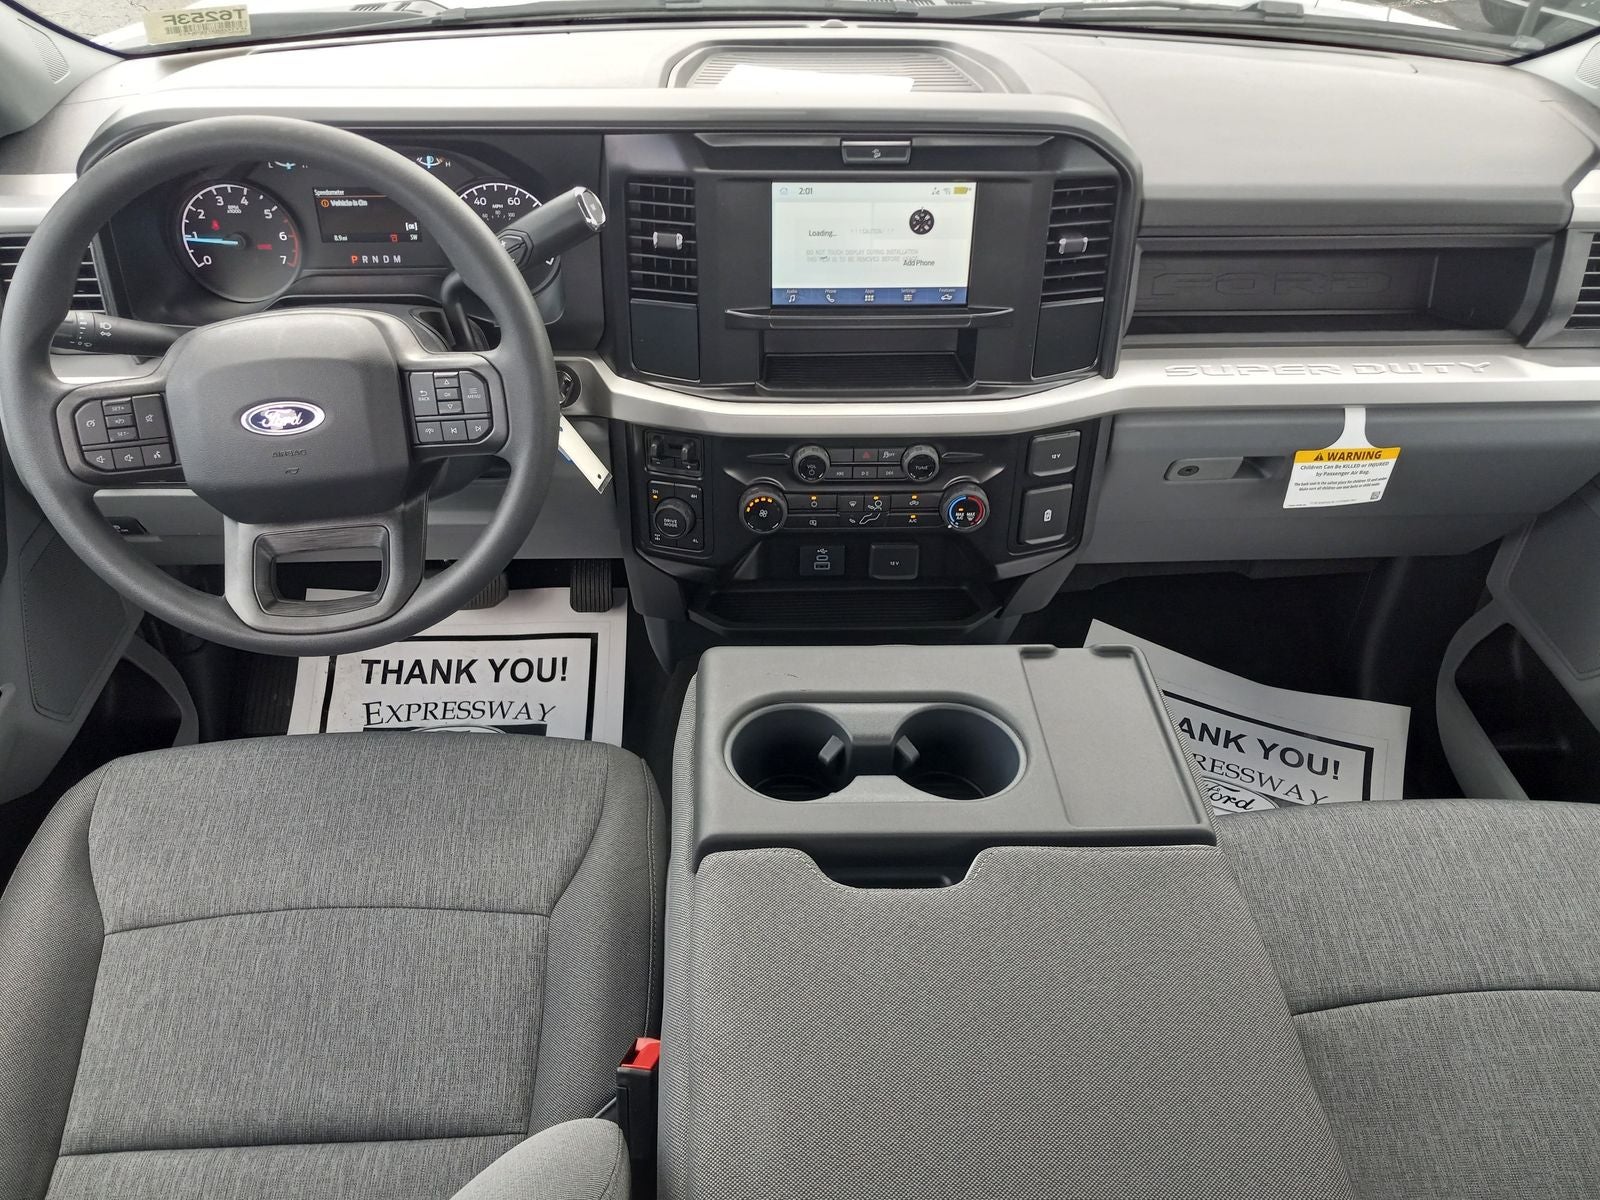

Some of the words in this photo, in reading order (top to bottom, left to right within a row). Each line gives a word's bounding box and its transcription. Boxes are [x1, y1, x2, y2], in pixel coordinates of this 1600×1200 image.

[314, 189, 345, 197] Speedometer
[798, 187, 813, 195] 2:01
[216, 196, 224, 206] 3
[240, 196, 249, 206] 4
[473, 197, 487, 206] 40
[507, 197, 521, 206] 60
[197, 209, 206, 219] 2
[263, 209, 273, 219] 5
[279, 231, 288, 240] 6
[203, 255, 212, 265] 0
[279, 255, 287, 264] 7
[351, 255, 358, 264] P
[362, 255, 369, 263] R
[372, 255, 379, 263] N
[383, 255, 389, 263] D
[393, 255, 401, 263] M
[1152, 271, 1392, 297] FORD
[1163, 363, 1344, 378] SUPER
[1351, 361, 1492, 377] DUTY
[260, 408, 304, 430] Ford
[1327, 450, 1382, 461] WARNING
[361, 658, 479, 685] THANK
[487, 656, 568, 684] YOU!
[362, 700, 556, 726] EXPRESSWAY
[1178, 716, 1248, 754] ANK
[1257, 737, 1341, 781] YOU!
[1192, 753, 1328, 808] RESSWAY
